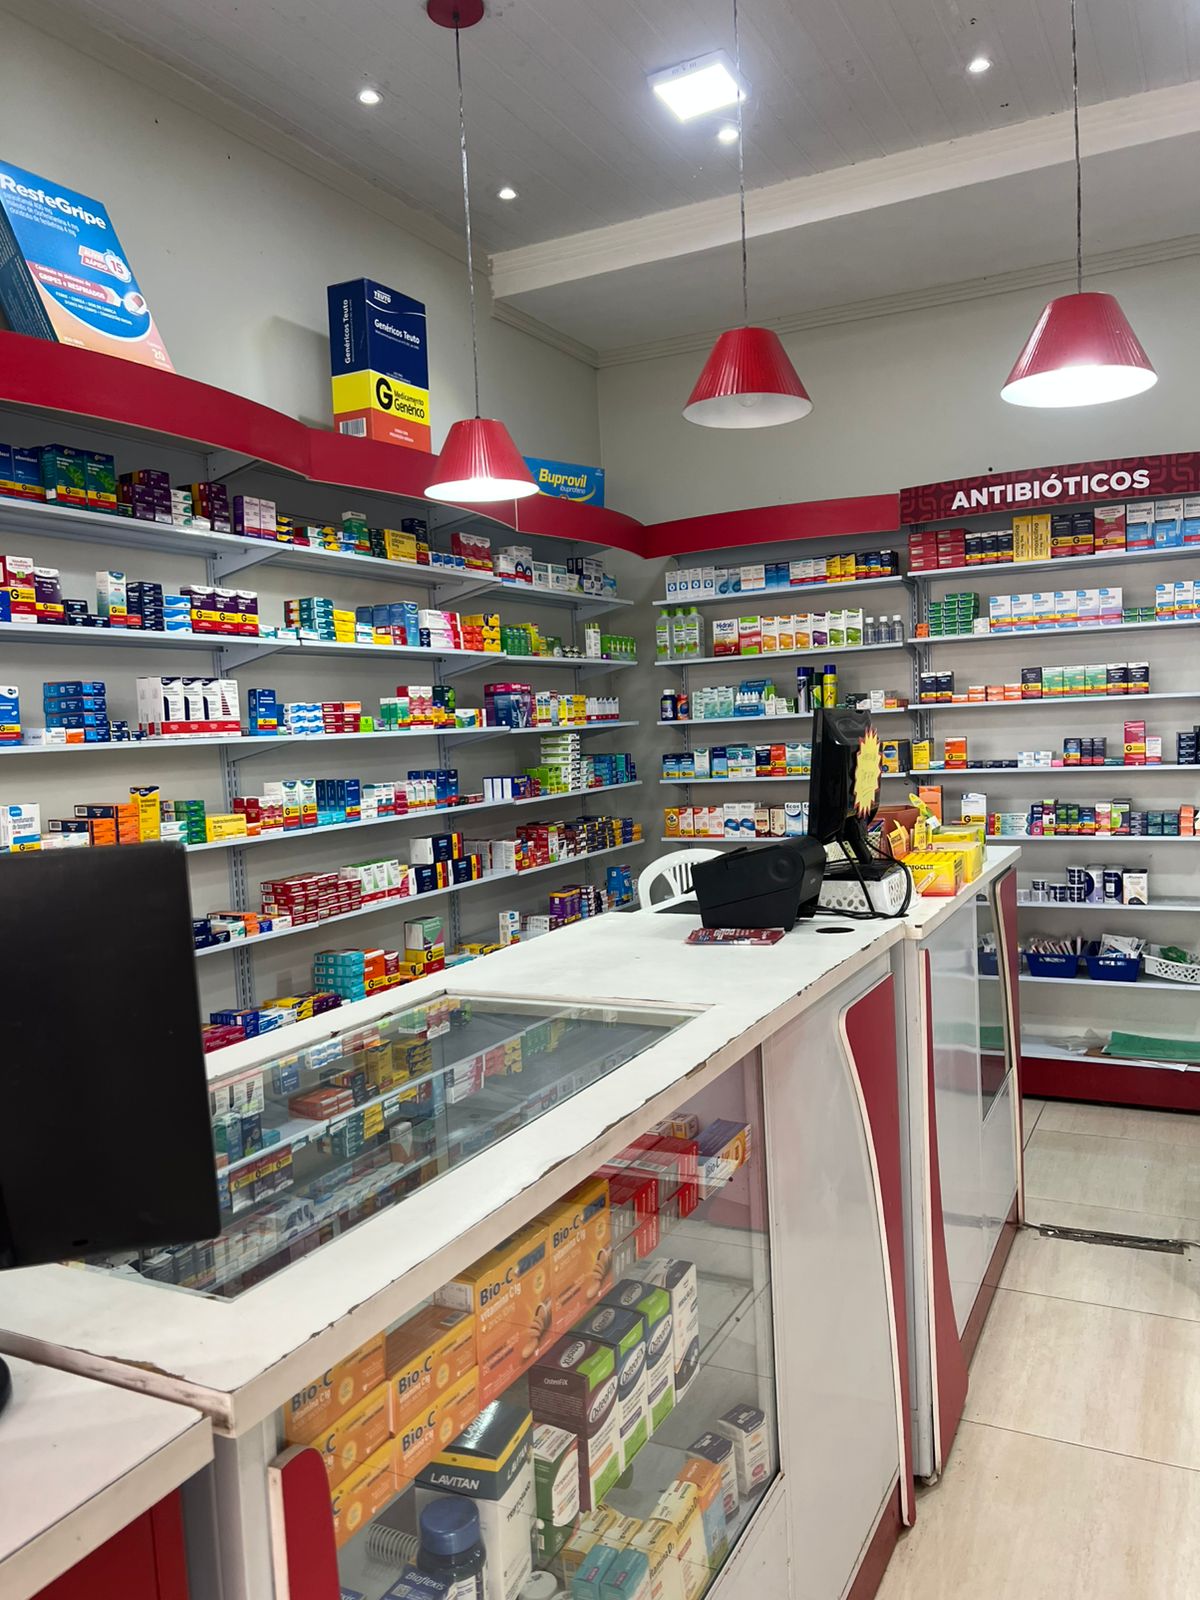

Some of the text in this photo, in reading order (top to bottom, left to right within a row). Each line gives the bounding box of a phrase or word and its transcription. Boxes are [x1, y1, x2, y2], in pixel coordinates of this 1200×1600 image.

[0, 173, 106, 230] ResfeGripe
[374, 319, 403, 338] Genéricos
[403, 330, 420, 345] Teuto
[376, 377, 393, 411] G
[394, 398, 424, 419] Genérico
[538, 467, 587, 488] Buprovil
[951, 469, 1151, 511] ANTIBIÓTICOS
[10, 589, 19, 600] G
[196, 610, 202, 619] G
[219, 612, 226, 621] G
[241, 614, 247, 622] G
[963, 815, 971, 823] G
[425, 950, 433, 961] G
[430, 1473, 480, 1490] LAVITAN
[405, 1571, 446, 1591] Bioflexis
